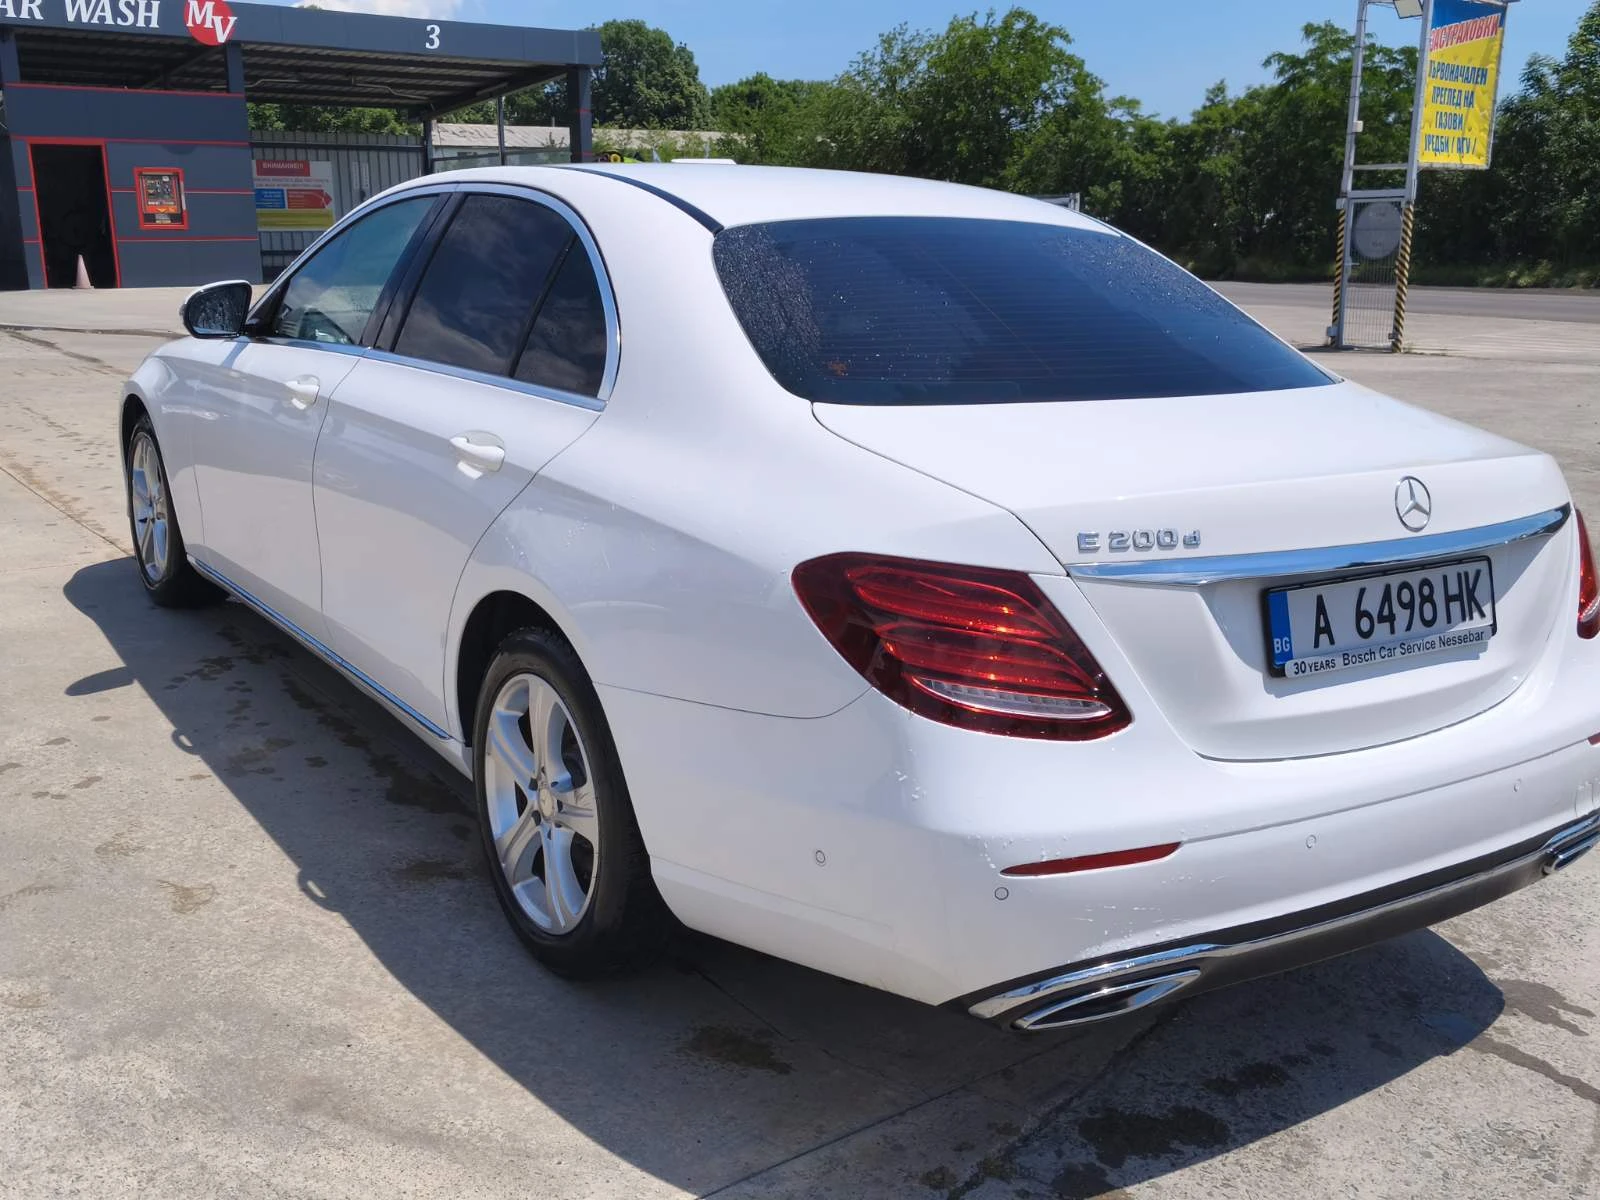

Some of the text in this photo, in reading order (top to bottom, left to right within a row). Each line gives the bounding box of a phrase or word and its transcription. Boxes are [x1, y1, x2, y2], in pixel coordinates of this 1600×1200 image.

[65, 0, 160, 28] WASH
[187, 0, 238, 43] MV
[425, 24, 441, 49] 3
[1463, 89, 1475, 109] НА
[1435, 111, 1464, 131] ГАЗОВИ
[1076, 531, 1101, 553] E
[1313, 594, 1336, 649] A
[1355, 577, 1438, 640] 6498
[1272, 636, 1292, 654] BG
[1293, 631, 1485, 676] 30 YEARS Bosch Car Service Nessebar
